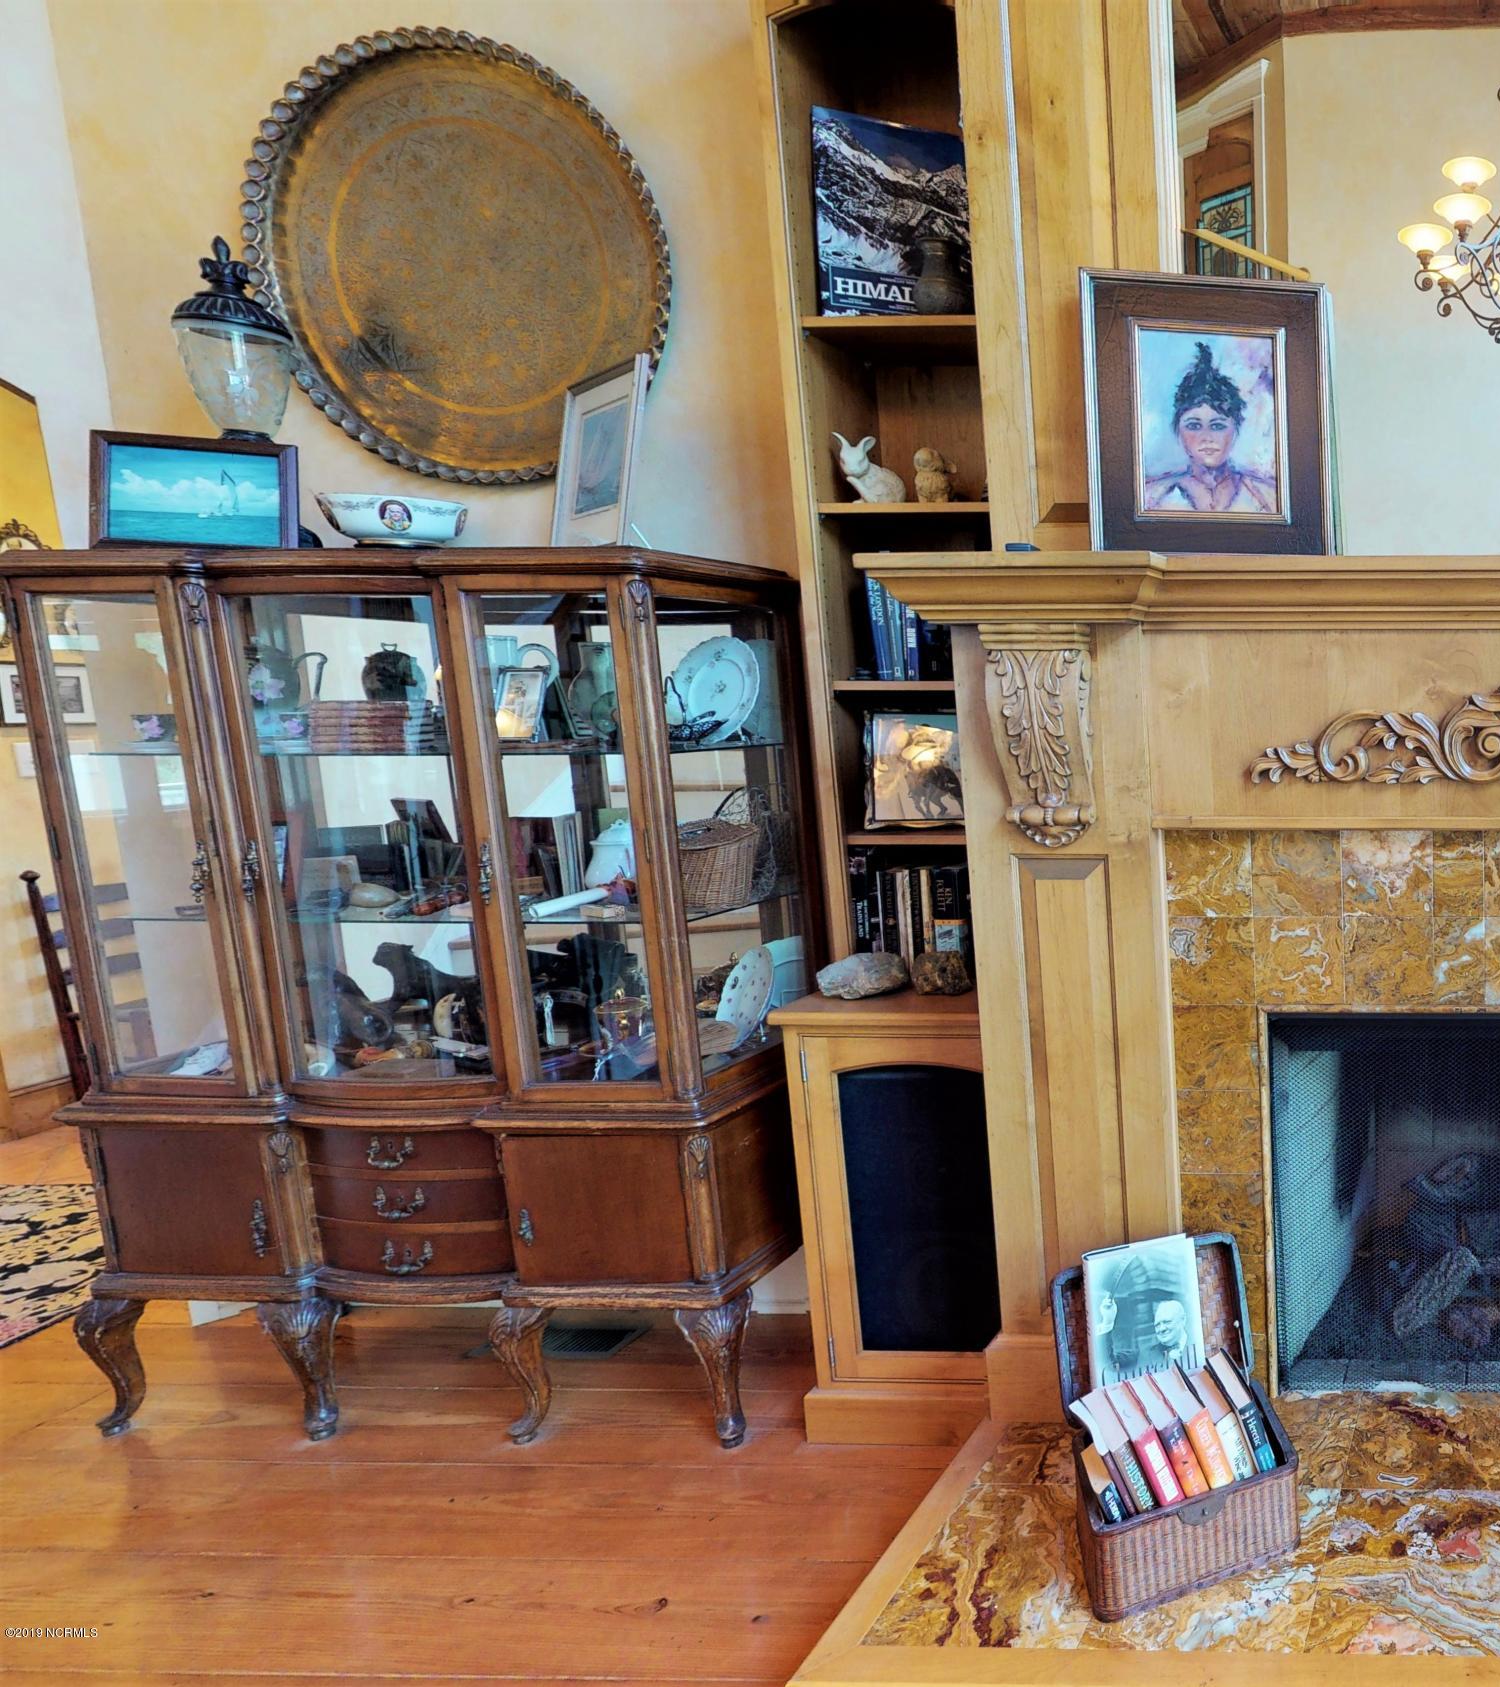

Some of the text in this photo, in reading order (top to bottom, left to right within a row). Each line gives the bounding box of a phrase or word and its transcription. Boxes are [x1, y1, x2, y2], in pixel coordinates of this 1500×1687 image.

[936, 880, 946, 911] FOLLETT
[1246, 1416, 1262, 1446] Heretic
[1125, 1458, 1155, 1510] HISTORY
